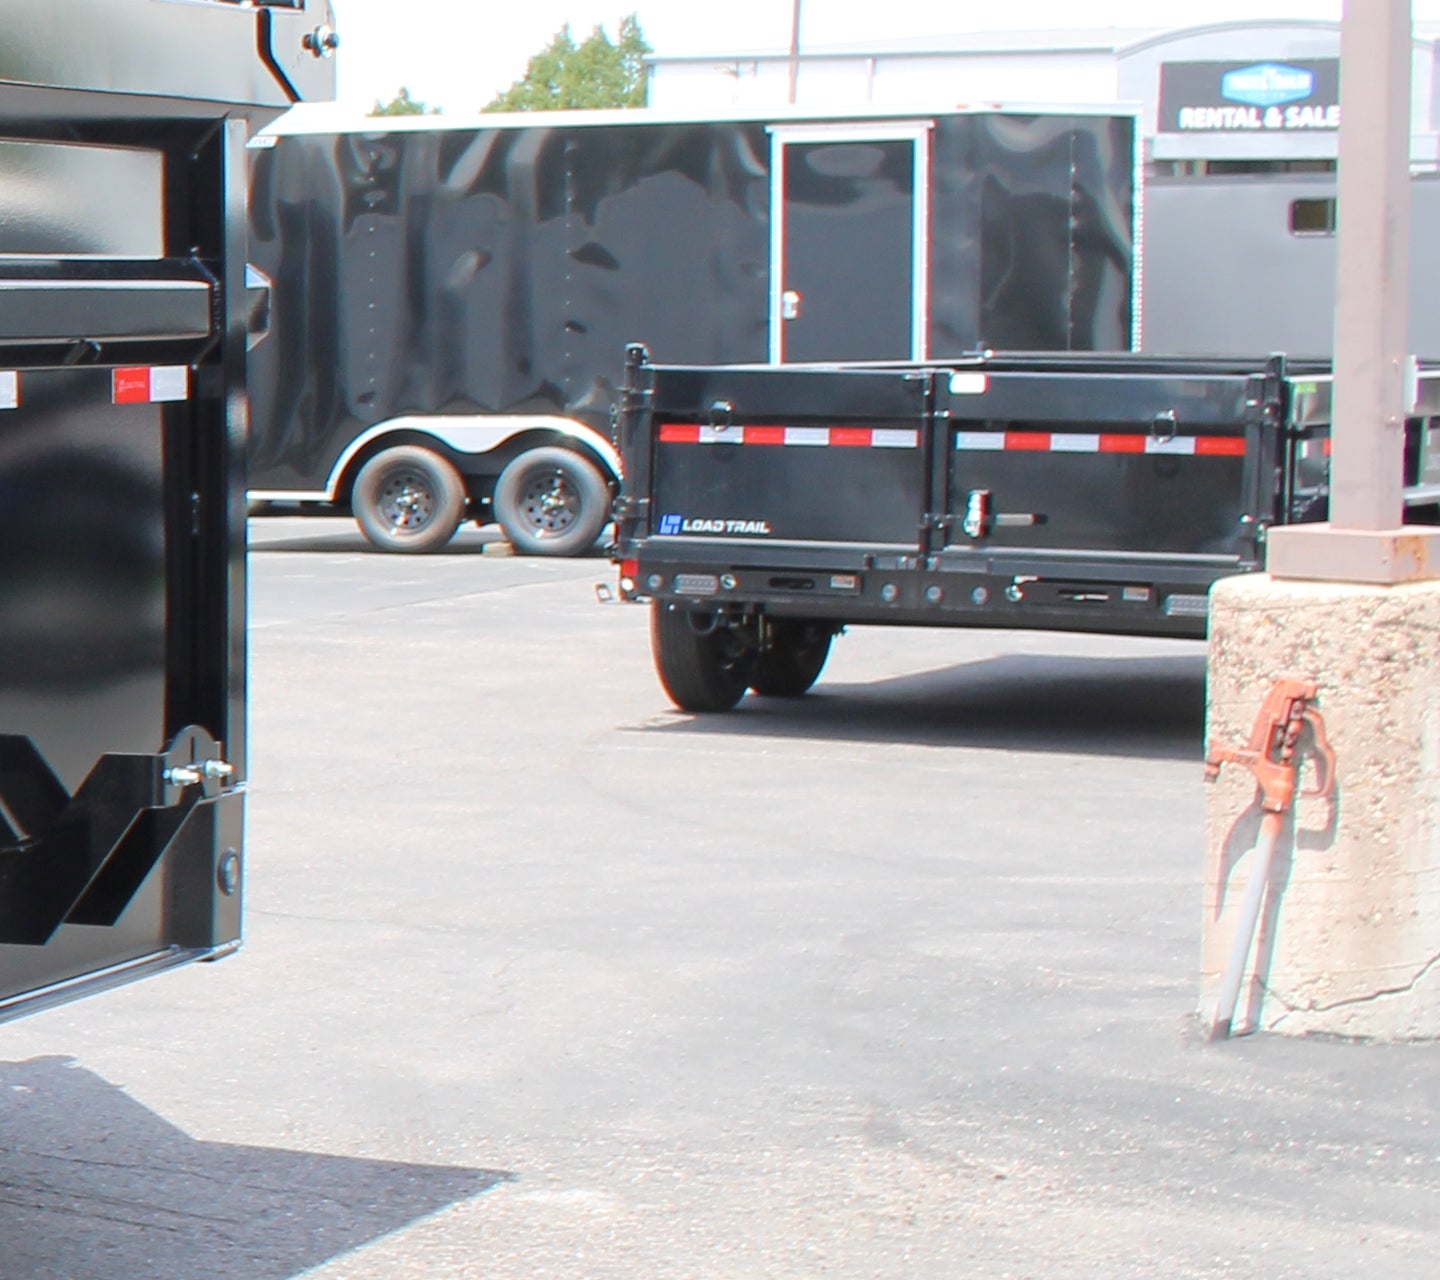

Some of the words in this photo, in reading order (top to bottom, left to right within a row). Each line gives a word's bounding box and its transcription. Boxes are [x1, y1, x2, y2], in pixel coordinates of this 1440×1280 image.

[1179, 106, 1262, 130] RENTAL
[1263, 105, 1284, 129] &
[682, 519, 725, 532] LOAD
[725, 519, 771, 534] TRAIL
